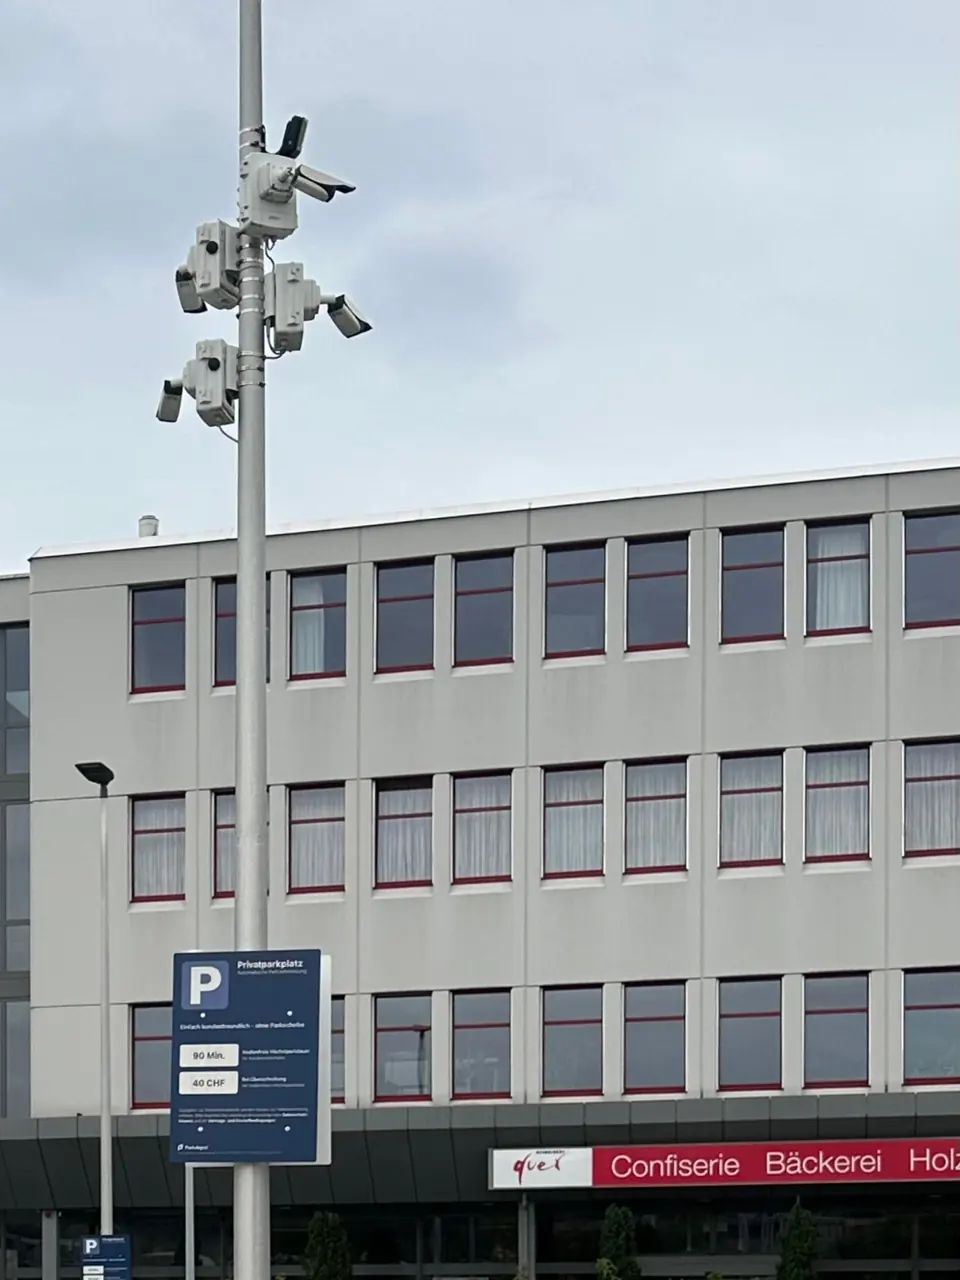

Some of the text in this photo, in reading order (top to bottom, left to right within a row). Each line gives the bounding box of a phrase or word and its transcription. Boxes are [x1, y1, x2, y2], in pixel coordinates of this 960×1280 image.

[237, 959, 304, 970] Privatparkplatz
[190, 966, 221, 1005] P
[193, 1050, 226, 1060] 90 Min.
[192, 1078, 226, 1087] 40 CHF
[611, 1153, 740, 1178] Confiserie
[766, 1149, 882, 1175] Bäckerei
[86, 1239, 98, 1254] P
